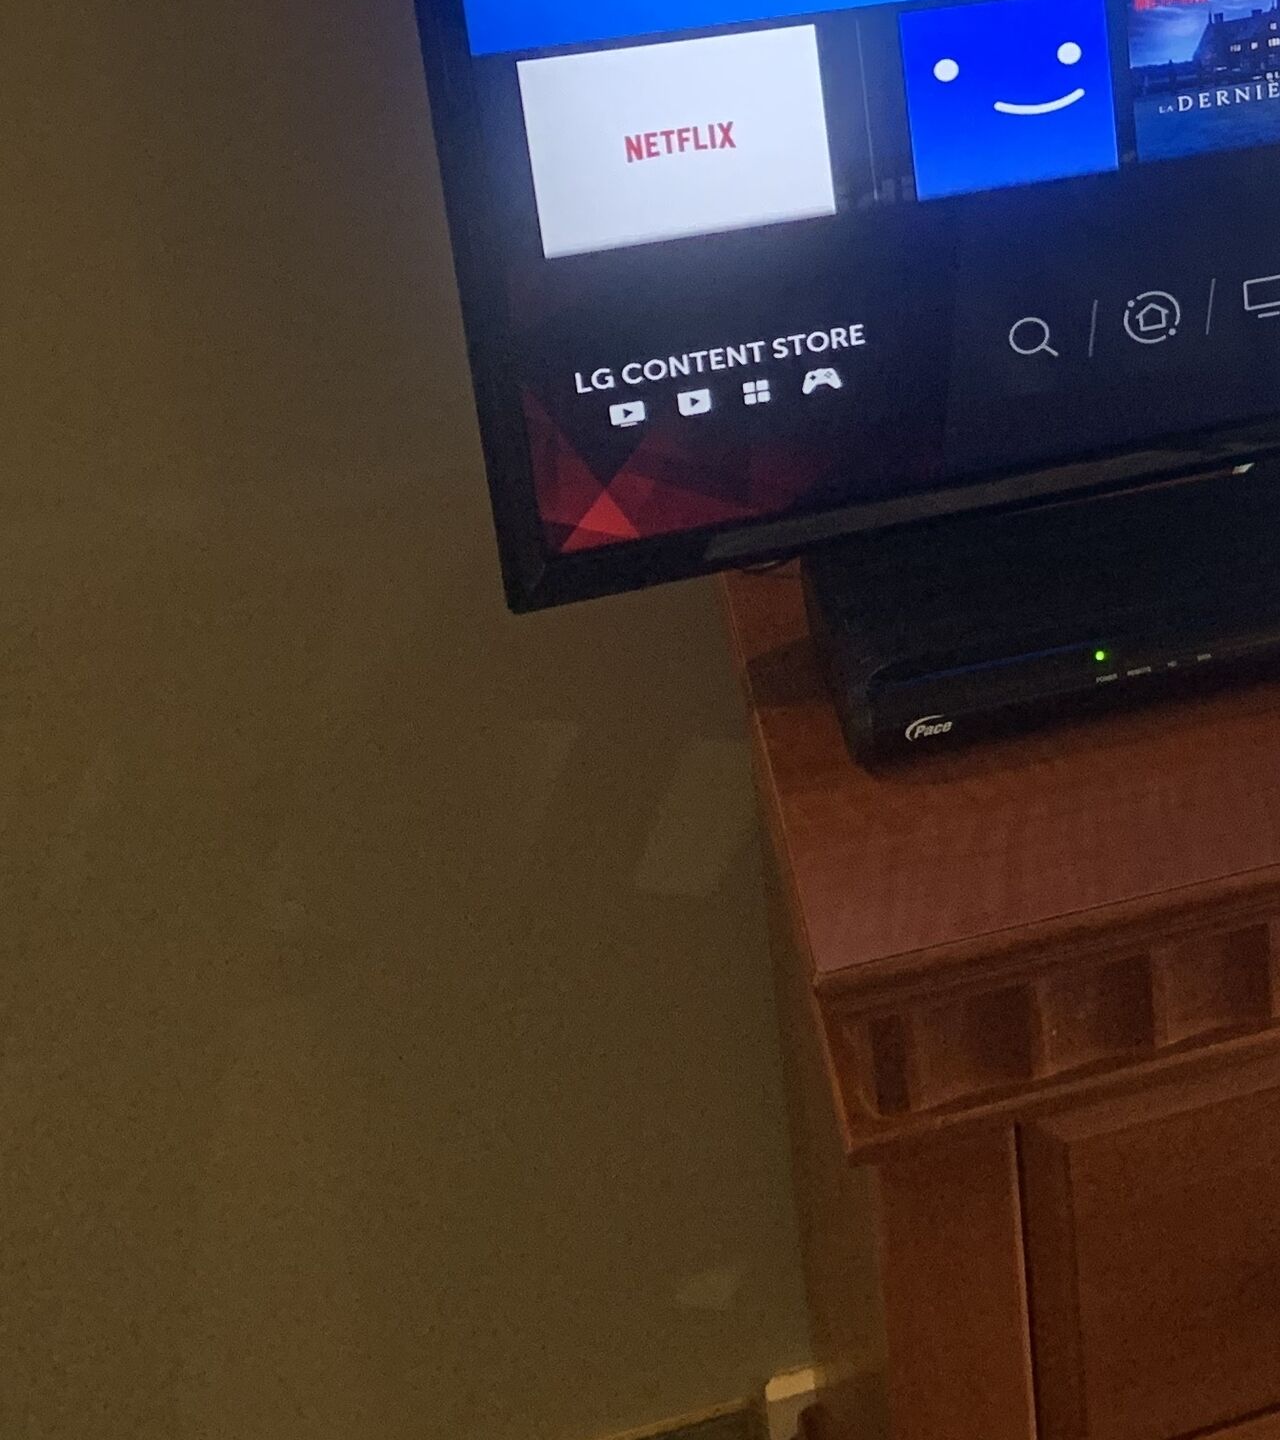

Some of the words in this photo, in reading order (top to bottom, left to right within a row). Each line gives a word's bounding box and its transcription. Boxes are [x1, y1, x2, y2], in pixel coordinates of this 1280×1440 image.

[624, 121, 736, 163] NETFLIX
[575, 367, 615, 394] LG
[621, 340, 766, 385] CONTENT
[772, 324, 866, 359] STORE
[913, 720, 953, 740] Pace
